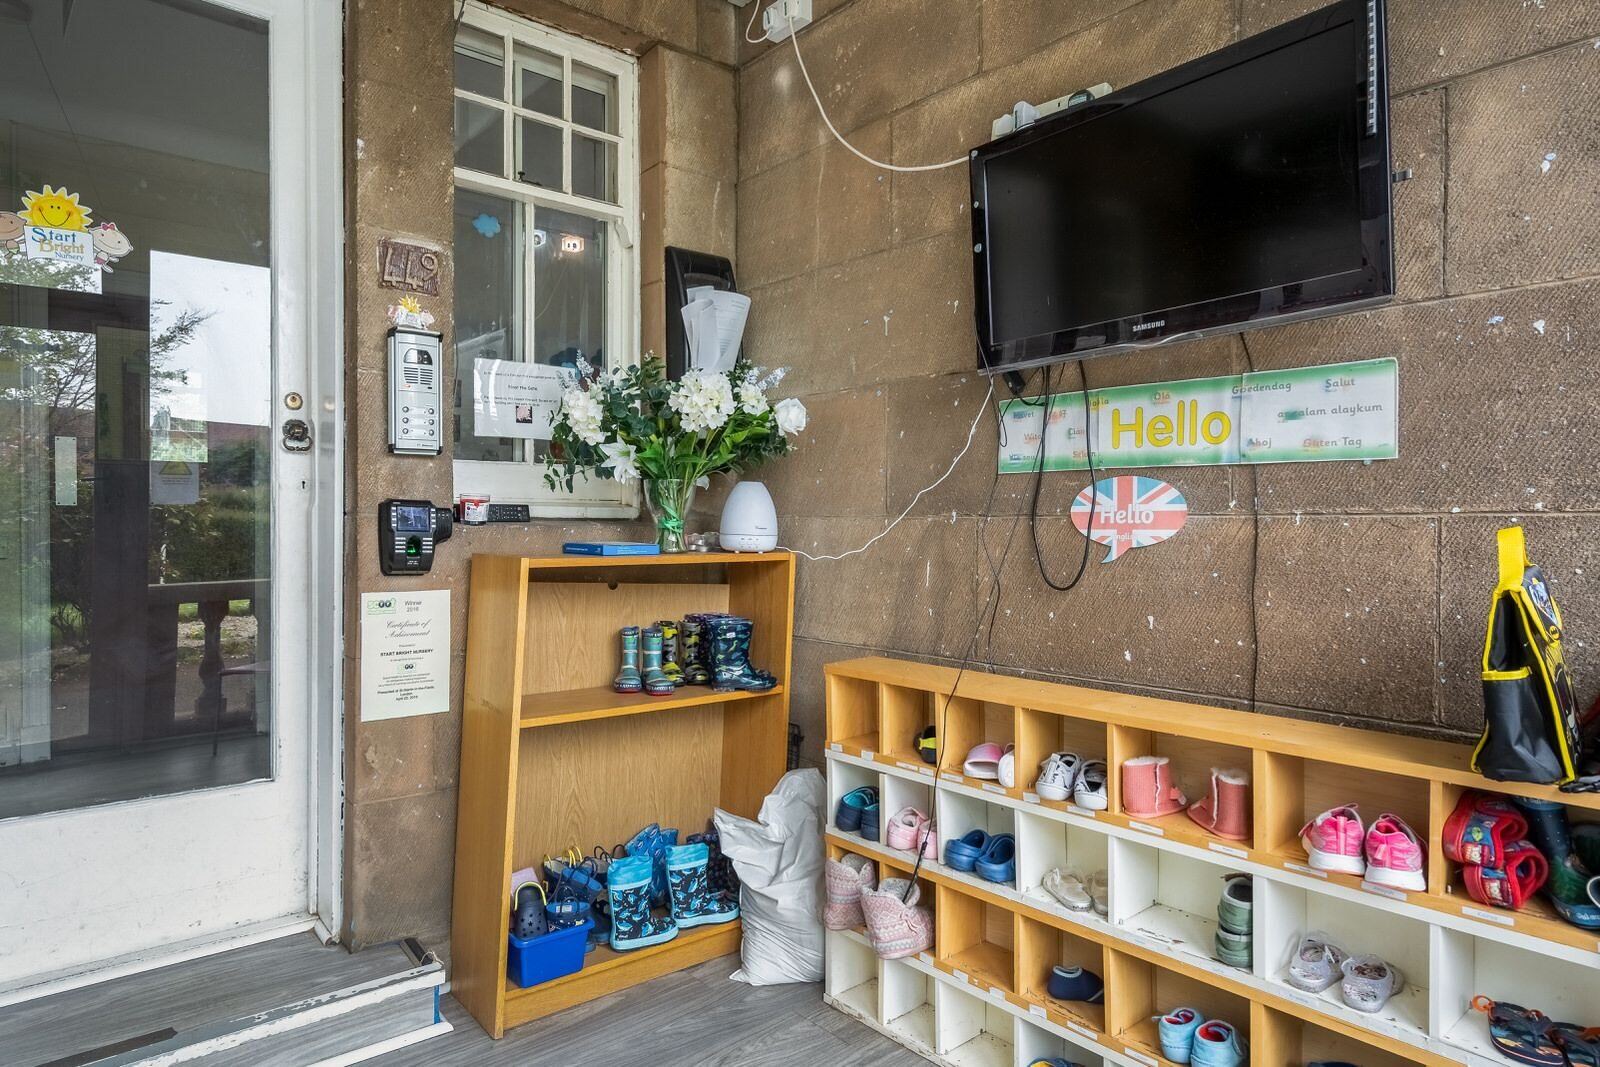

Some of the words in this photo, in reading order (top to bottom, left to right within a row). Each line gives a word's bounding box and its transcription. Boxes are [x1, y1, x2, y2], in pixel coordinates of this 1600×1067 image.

[31, 227, 77, 243] Start
[39, 239, 85, 254] Bright
[55, 251, 85, 262] Nursery
[1132, 320, 1166, 332] SAMSUNG
[1232, 382, 1292, 395] Goedendag
[1325, 378, 1356, 389] Salut
[1331, 403, 1383, 417] alaykum
[1112, 399, 1232, 449] Hello
[1247, 437, 1272, 449] Ahoj
[1303, 438, 1338, 448] Guten
[1342, 436, 1363, 449] Tag
[1100, 503, 1155, 524] Hello
